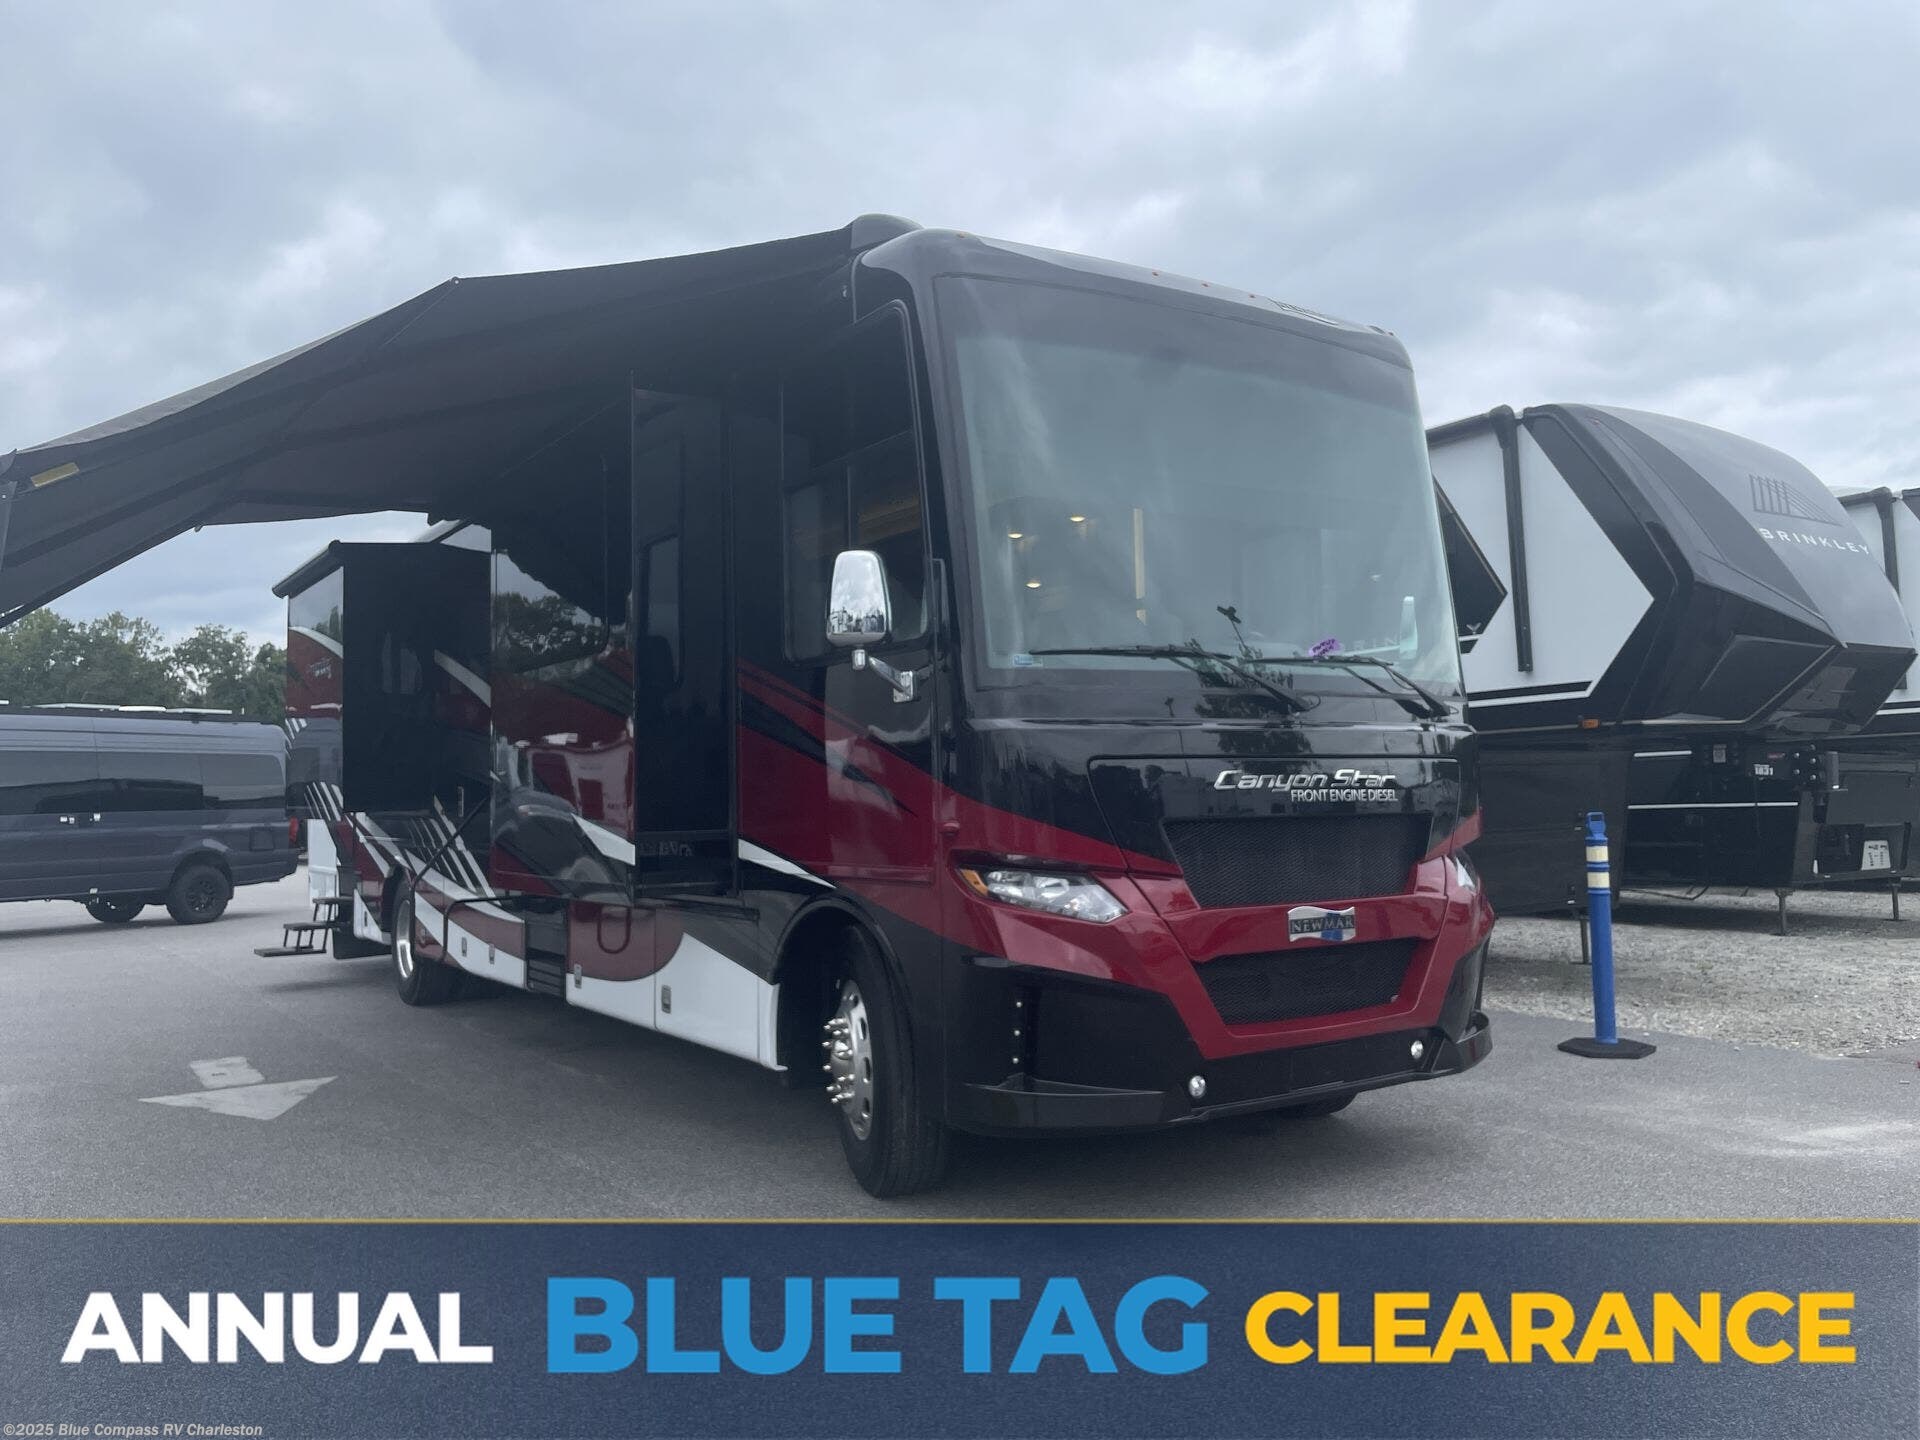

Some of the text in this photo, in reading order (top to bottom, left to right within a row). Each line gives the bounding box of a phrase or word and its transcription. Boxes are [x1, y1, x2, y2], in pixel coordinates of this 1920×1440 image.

[1759, 527, 1869, 555] BRINKLEY
[1213, 769, 1396, 793] Canyon Star
[1290, 788, 1399, 802] FRONT ENGINE DIESEL
[1291, 916, 1354, 933] NEWMAR
